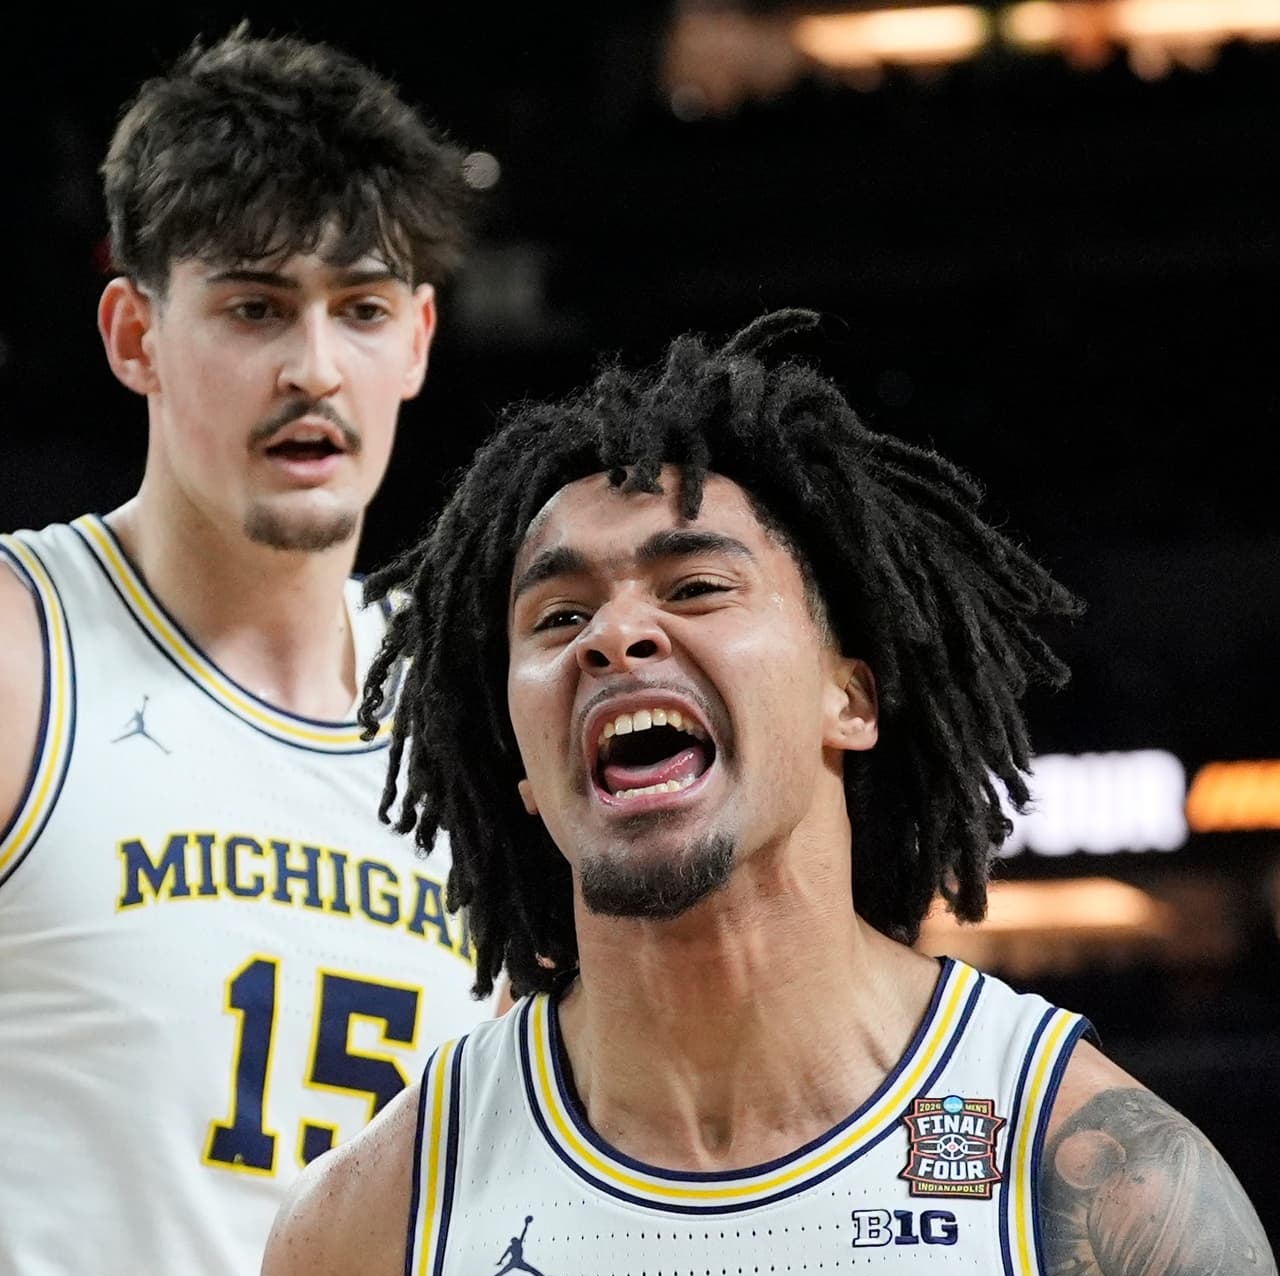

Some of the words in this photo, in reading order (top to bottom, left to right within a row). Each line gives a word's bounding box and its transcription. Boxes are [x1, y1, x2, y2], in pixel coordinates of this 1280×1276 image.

[115, 832, 477, 967] MICHIGA
[201, 951, 423, 1178] 15
[917, 1114, 986, 1138] FINAL
[918, 1158, 985, 1180] FOUR
[918, 1182, 984, 1193] INDIANAPOLIS
